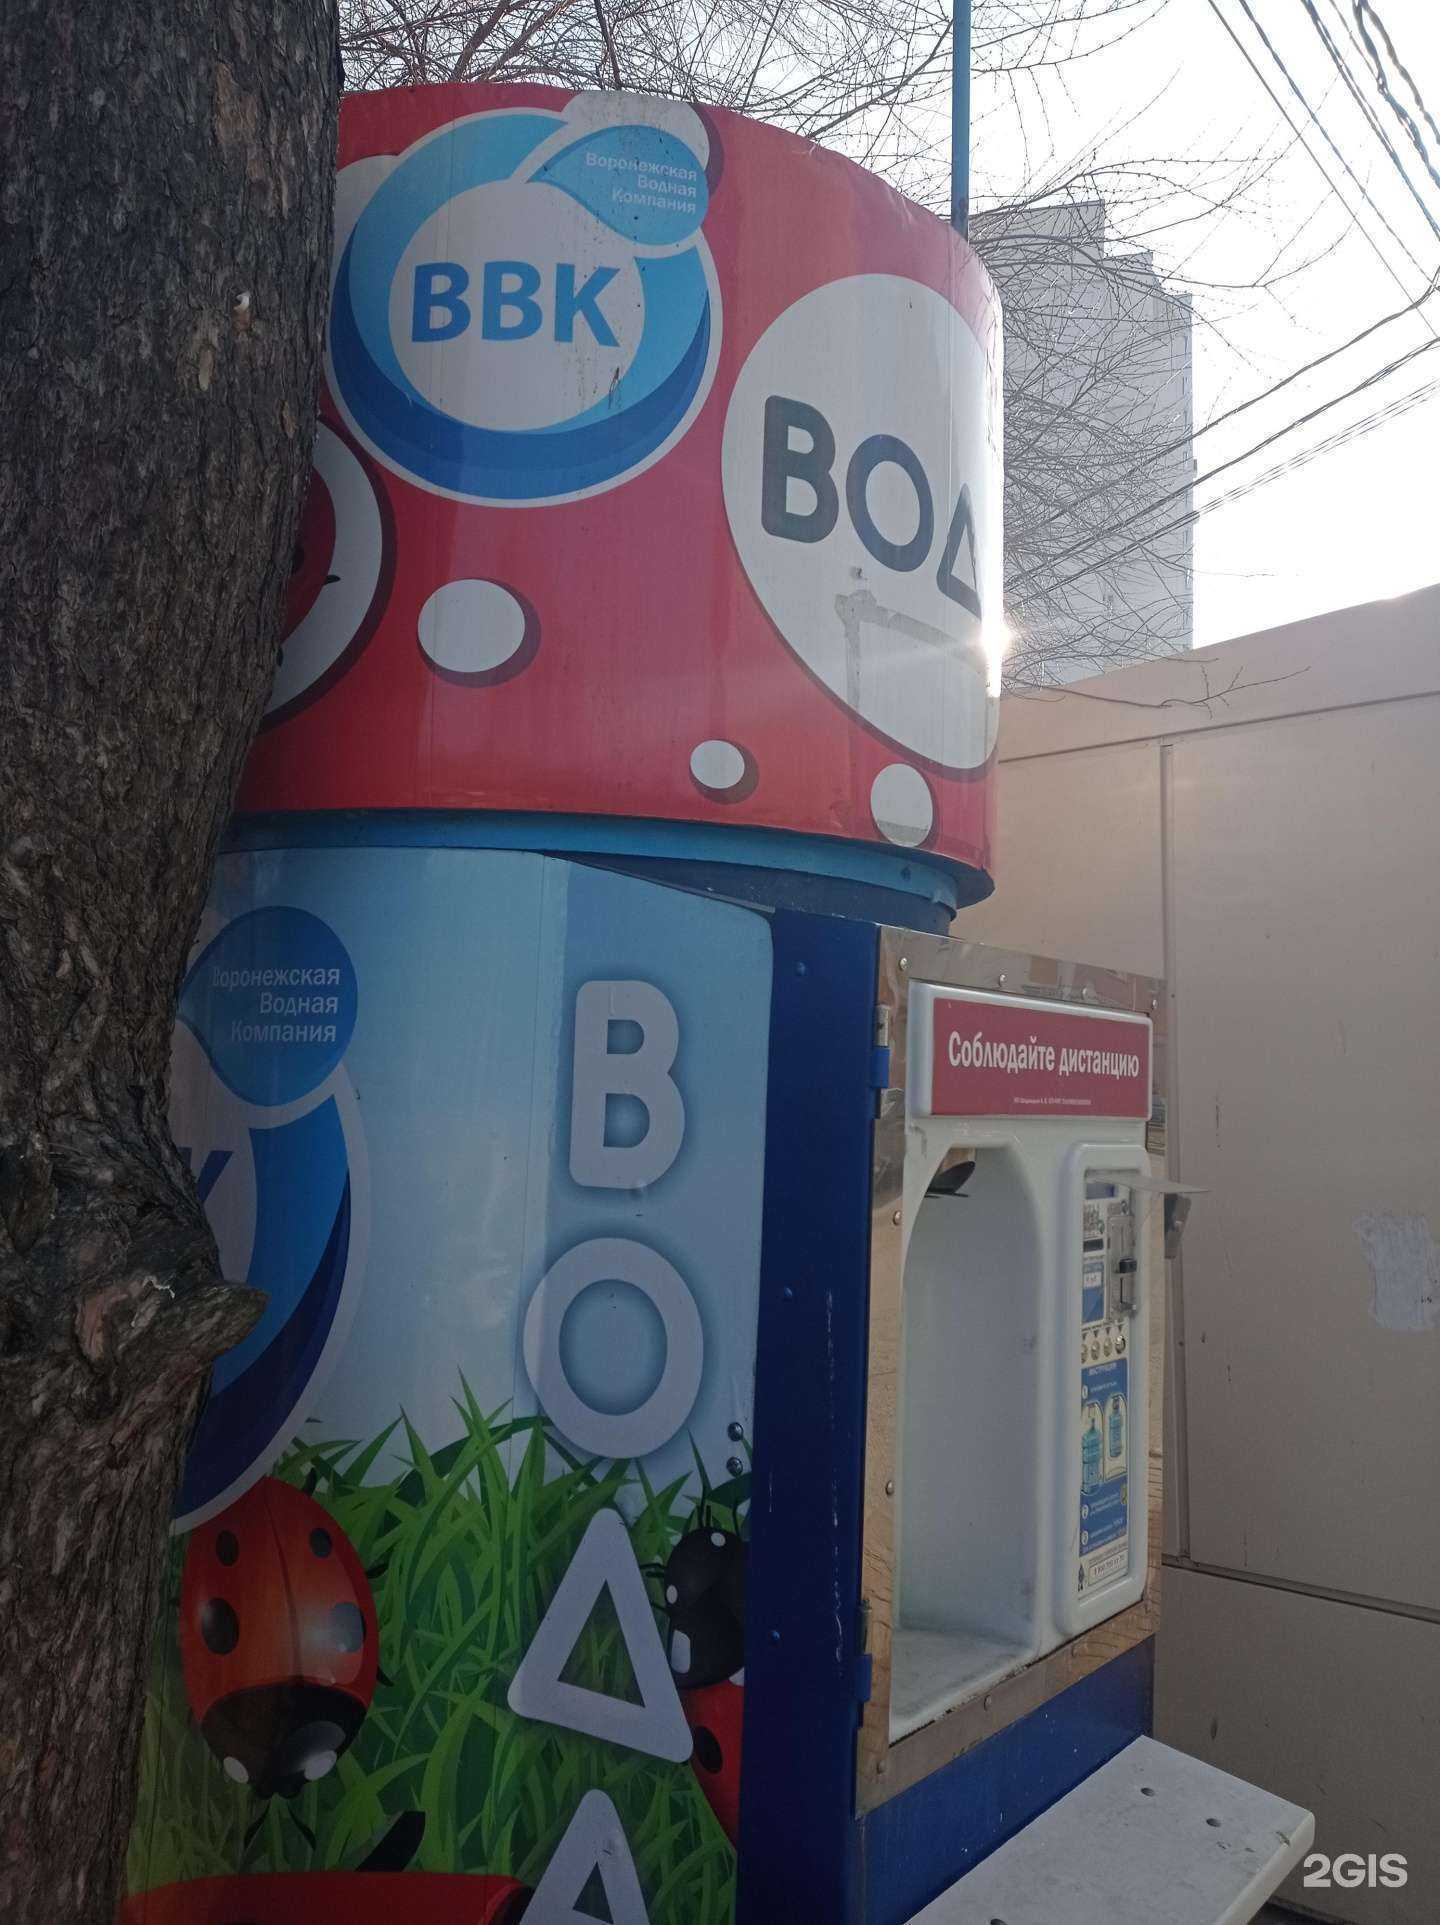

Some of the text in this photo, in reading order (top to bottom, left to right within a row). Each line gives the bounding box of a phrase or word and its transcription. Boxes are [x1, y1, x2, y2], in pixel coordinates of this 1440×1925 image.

[585, 152, 697, 181] Воронежская
[612, 186, 696, 214] Компания
[637, 174, 697, 198] Водная
[411, 260, 620, 347] ВВК
[259, 991, 338, 1016] Водная
[231, 1019, 336, 1043] Компания
[949, 1031, 1139, 1080] Соблюдайте дистанцию
